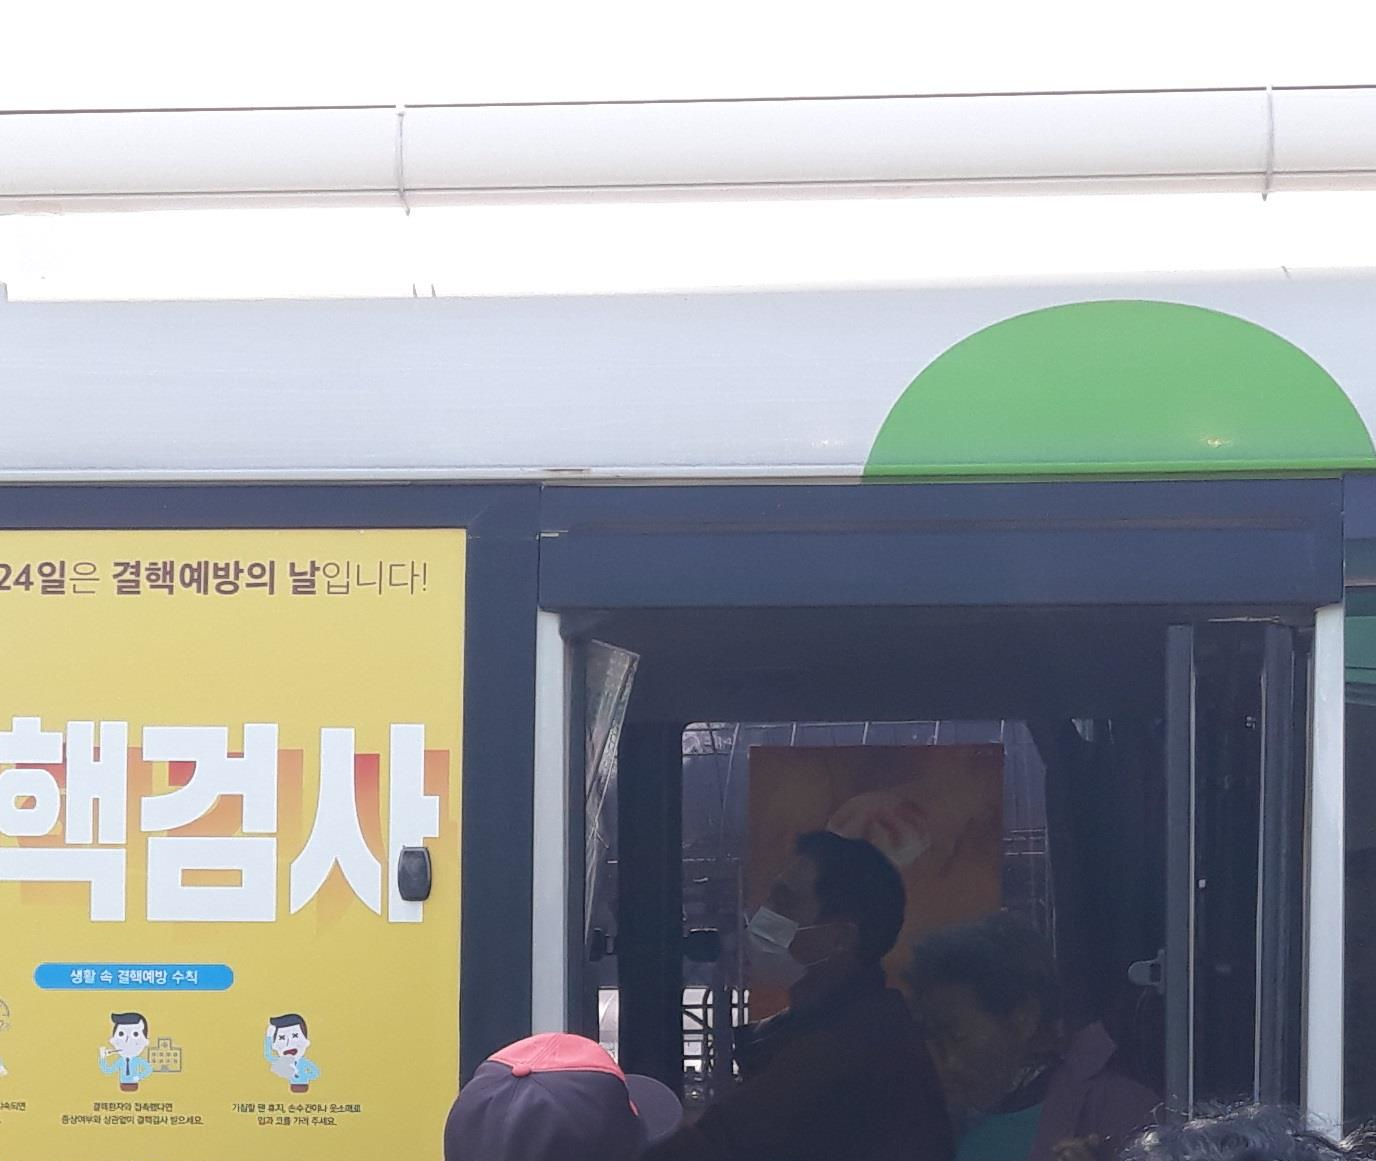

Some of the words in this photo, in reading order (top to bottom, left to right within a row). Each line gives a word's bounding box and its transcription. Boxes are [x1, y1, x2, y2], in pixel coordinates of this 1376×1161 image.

[112, 561, 276, 596] 결핵예방의
[289, 561, 428, 596] 날입니다!
[70, 969, 96, 984] 생활
[100, 969, 113, 984] 속
[118, 969, 167, 985] 결핵예방
[172, 970, 198, 985] 수칙
